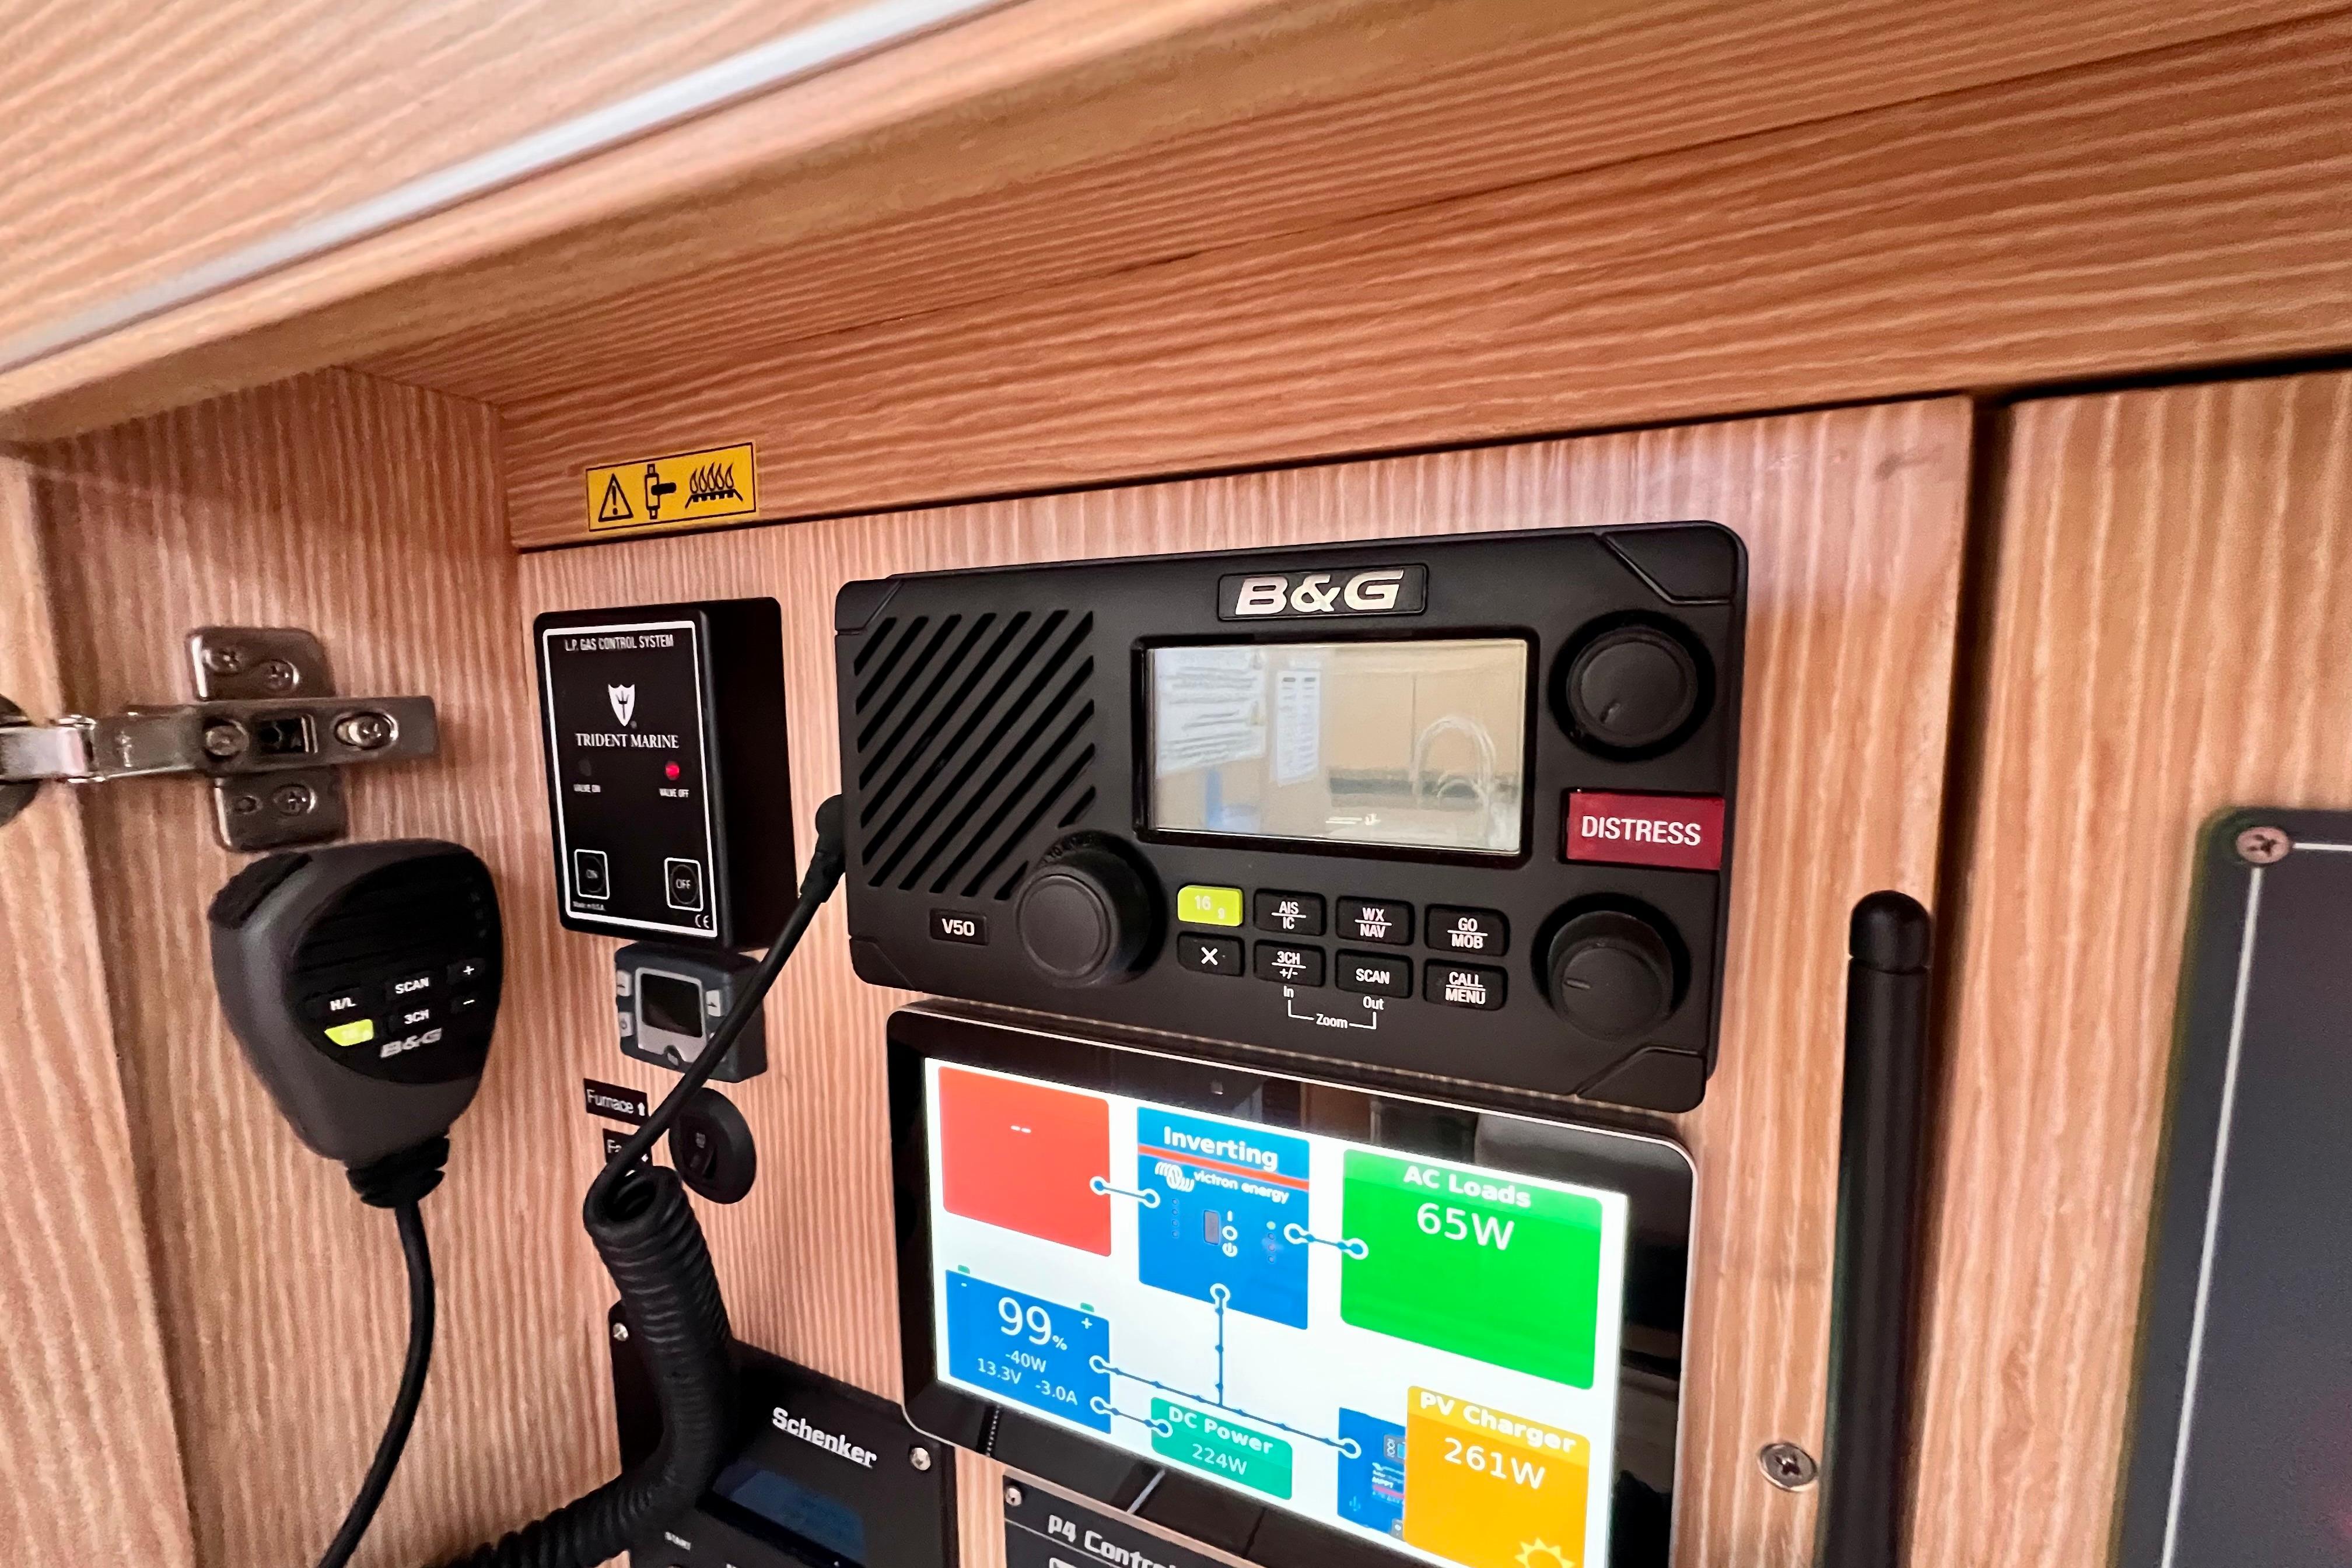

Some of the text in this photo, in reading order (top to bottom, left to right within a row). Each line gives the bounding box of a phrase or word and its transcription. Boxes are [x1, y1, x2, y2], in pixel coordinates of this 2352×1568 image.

[1236, 569, 1404, 615] B&G
[580, 638, 597, 650] GAS
[598, 636, 638, 650] CONTROL
[639, 634, 674, 649] SYSTEM
[575, 733, 680, 748] TRIDENT MARINE
[1581, 816, 1702, 846] DISTRESS
[676, 878, 691, 890] OFF
[1195, 895, 1212, 911] 16
[1279, 901, 1299, 914] AIS
[1362, 907, 1385, 922] WX
[942, 918, 975, 936] V50
[1283, 917, 1295, 930] IC
[1360, 923, 1385, 938] NAV
[1458, 918, 1478, 932] GO
[1451, 934, 1483, 949] MOB
[1277, 951, 1300, 965] 3CH
[1356, 968, 1390, 984] SCAN
[1449, 972, 1483, 987] CALL
[395, 977, 429, 994] SCAN
[1283, 986, 1294, 998] In
[330, 997, 357, 1011] H/L
[1363, 996, 1384, 1010] Out
[1445, 988, 1486, 1005] MENU
[404, 1009, 429, 1024] 3CH
[1316, 1013, 1348, 1028] Zoom
[380, 1027, 442, 1058] B&G
[586, 1088, 634, 1114] Furnace
[1163, 1126, 1278, 1172] Inverting
[1194, 1170, 1290, 1205] victron energy
[1402, 1166, 1531, 1208] AC Loads
[1416, 1202, 1515, 1251] 65W
[1006, 1350, 1046, 1373] -40W
[977, 1358, 1078, 1405] 13.3V -3.0A
[1168, 1406, 1274, 1454] DC Power
[1420, 1391, 1577, 1453] PV Charger
[772, 1407, 877, 1469] Schenker
[1192, 1443, 1247, 1475] 224W
[1444, 1437, 1546, 1490] 261W
[1084, 1530, 1177, 1568] Contr
